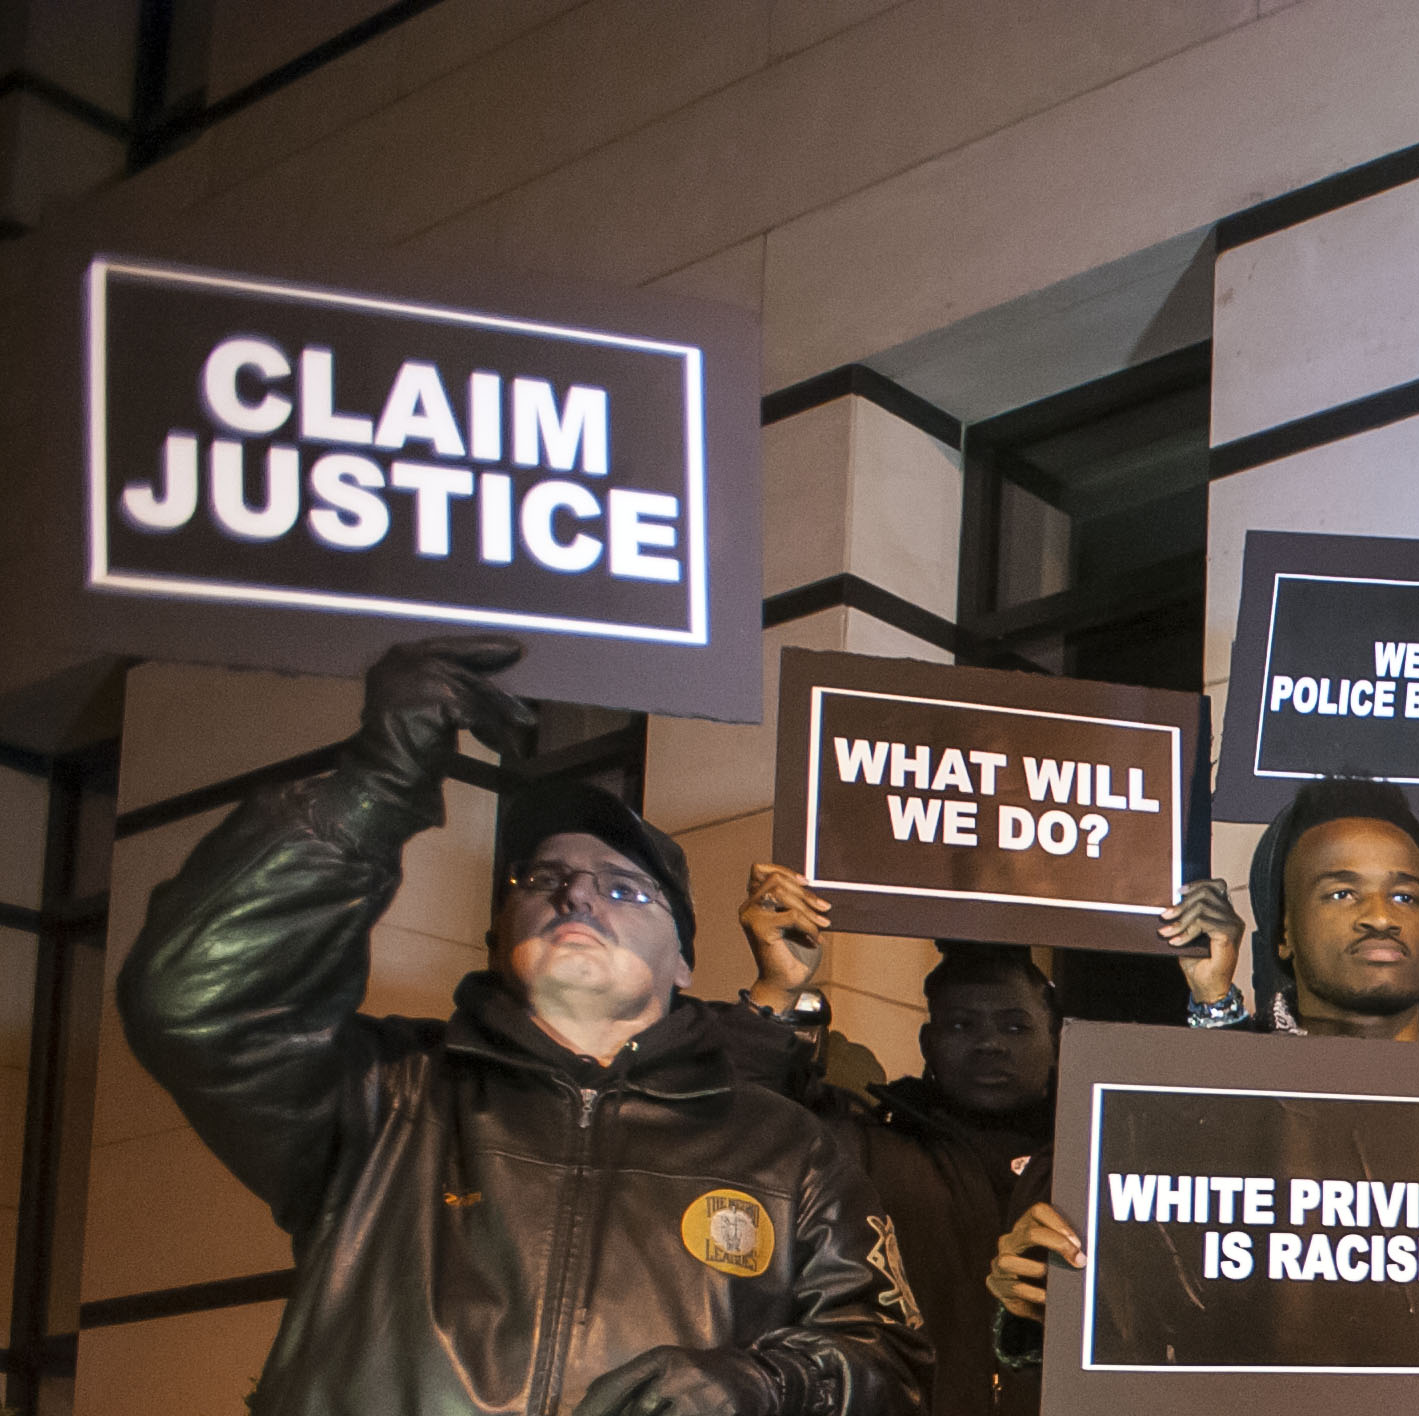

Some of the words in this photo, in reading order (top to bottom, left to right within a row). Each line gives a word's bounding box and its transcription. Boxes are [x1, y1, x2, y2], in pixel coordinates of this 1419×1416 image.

[204, 338, 609, 476] CLAIM
[121, 434, 681, 583] JUSTICE
[1270, 675, 1396, 718] POLICE
[834, 737, 1007, 796] WHAT
[1022, 756, 1160, 813] WILL
[887, 795, 978, 846] WE
[998, 805, 1109, 858] DO?
[1108, 1173, 1275, 1225] WHITE
[1204, 1231, 1253, 1280] IS
